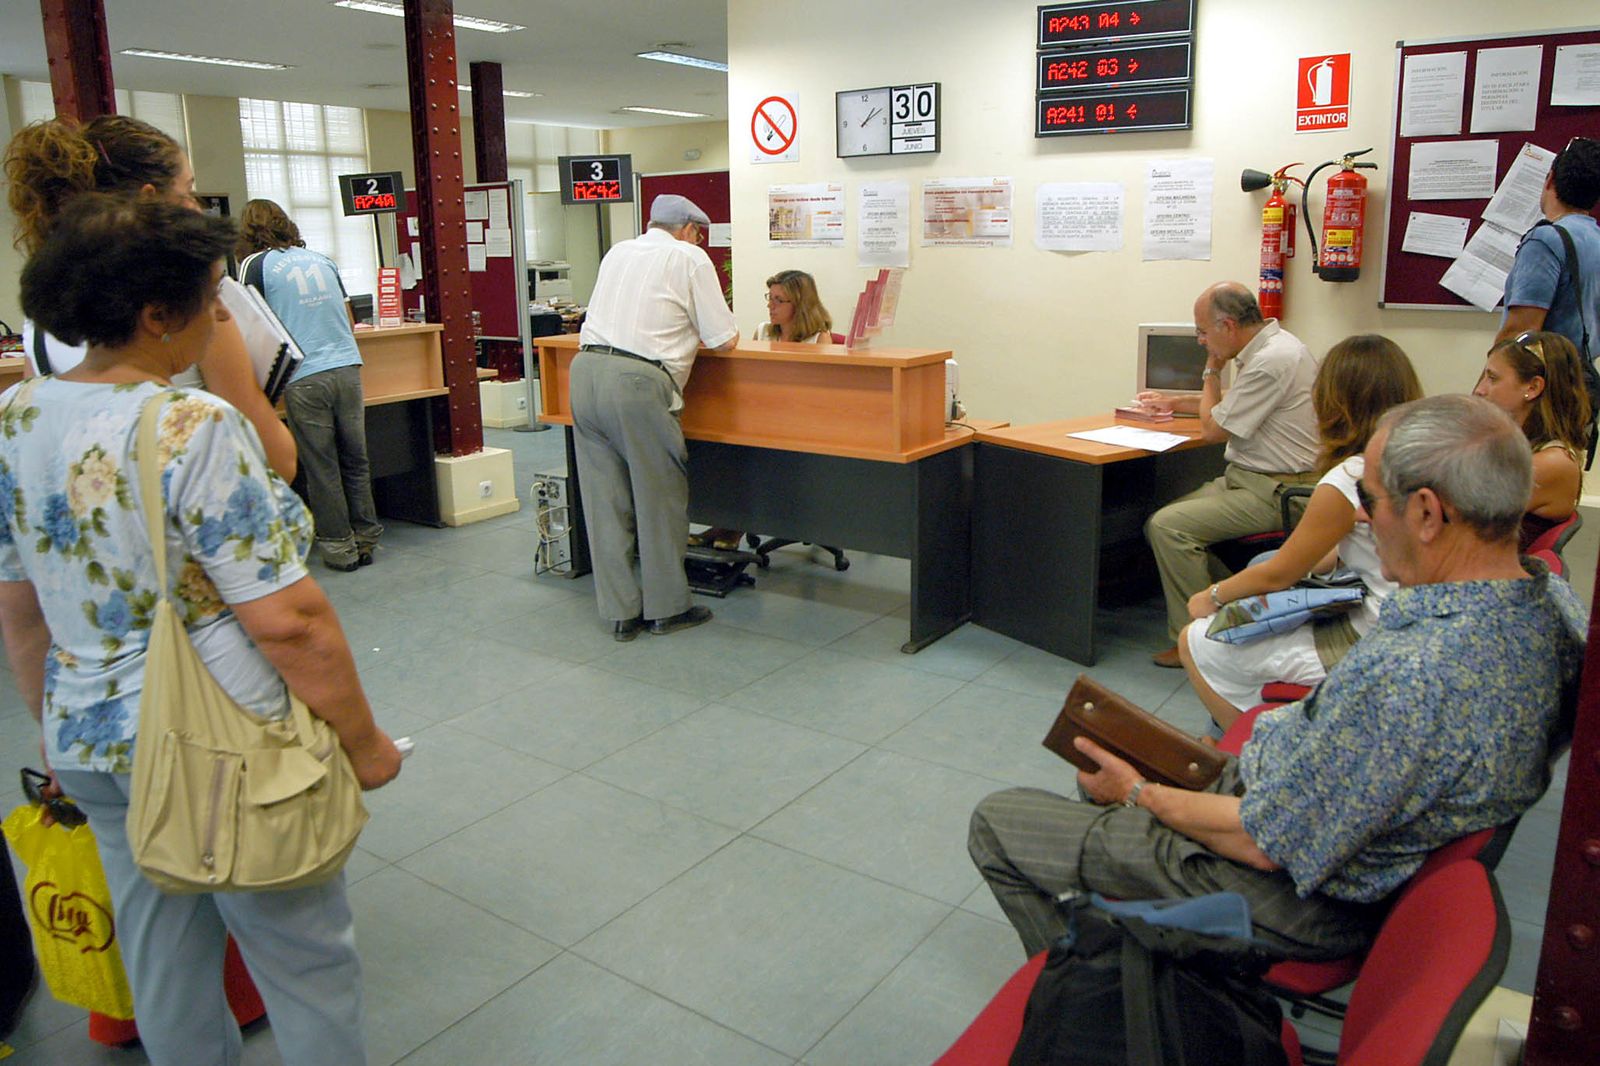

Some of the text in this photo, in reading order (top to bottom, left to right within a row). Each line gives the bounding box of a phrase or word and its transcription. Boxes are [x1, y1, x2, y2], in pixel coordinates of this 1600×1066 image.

[1049, 12, 1120, 33] A243 04
[1047, 58, 1119, 81] A242 03
[861, 94, 869, 102] 12
[895, 91, 932, 119] 30
[1046, 103, 1115, 125] A241 01
[1298, 112, 1347, 126] EXTINTOR
[843, 120, 848, 128] 9
[902, 127, 926, 136] JUEVES
[904, 143, 922, 151] JUNIO
[590, 161, 604, 180] 3
[366, 178, 379, 195] 2
[575, 180, 621, 199] A242
[354, 193, 396, 209] A240
[286, 263, 328, 295] 11
